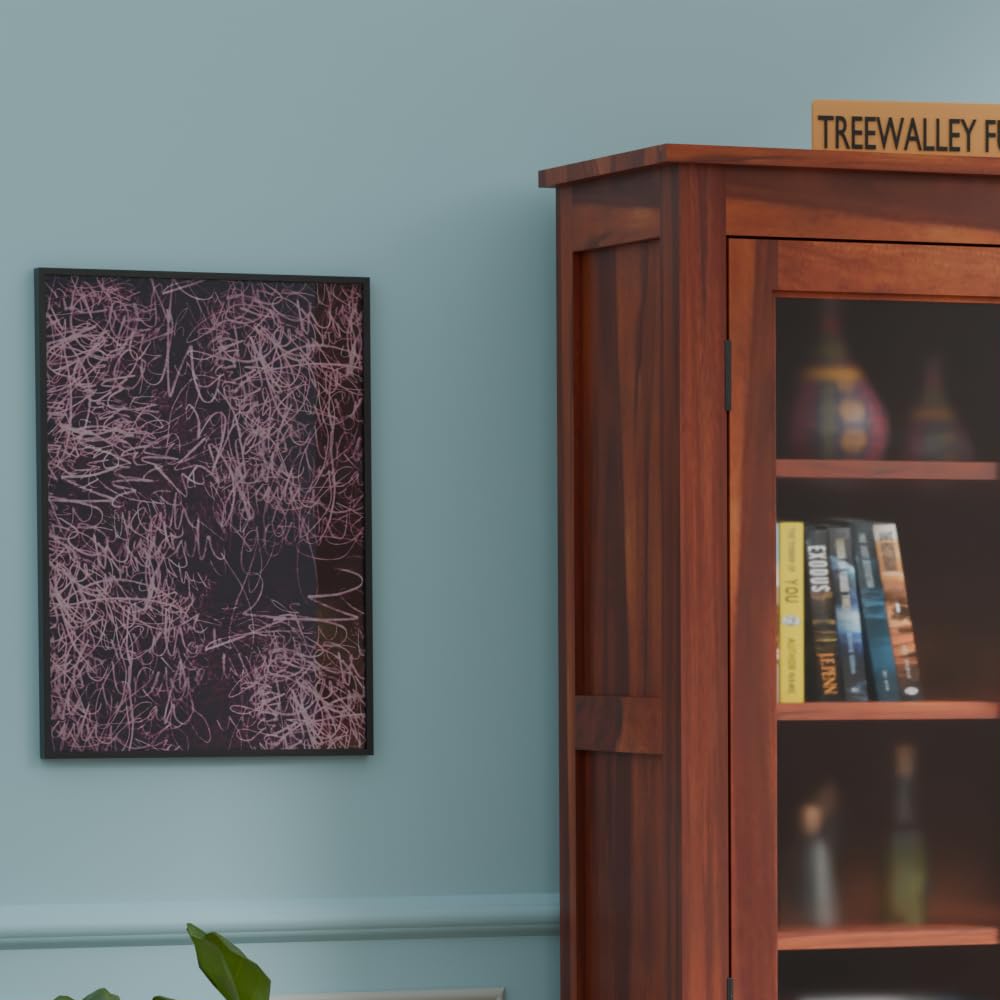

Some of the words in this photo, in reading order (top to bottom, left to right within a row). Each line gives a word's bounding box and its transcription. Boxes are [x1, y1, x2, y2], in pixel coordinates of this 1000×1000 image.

[817, 115, 977, 153] TREEWALLEY
[807, 544, 832, 593] EXODUS
[785, 578, 799, 605] YOU
